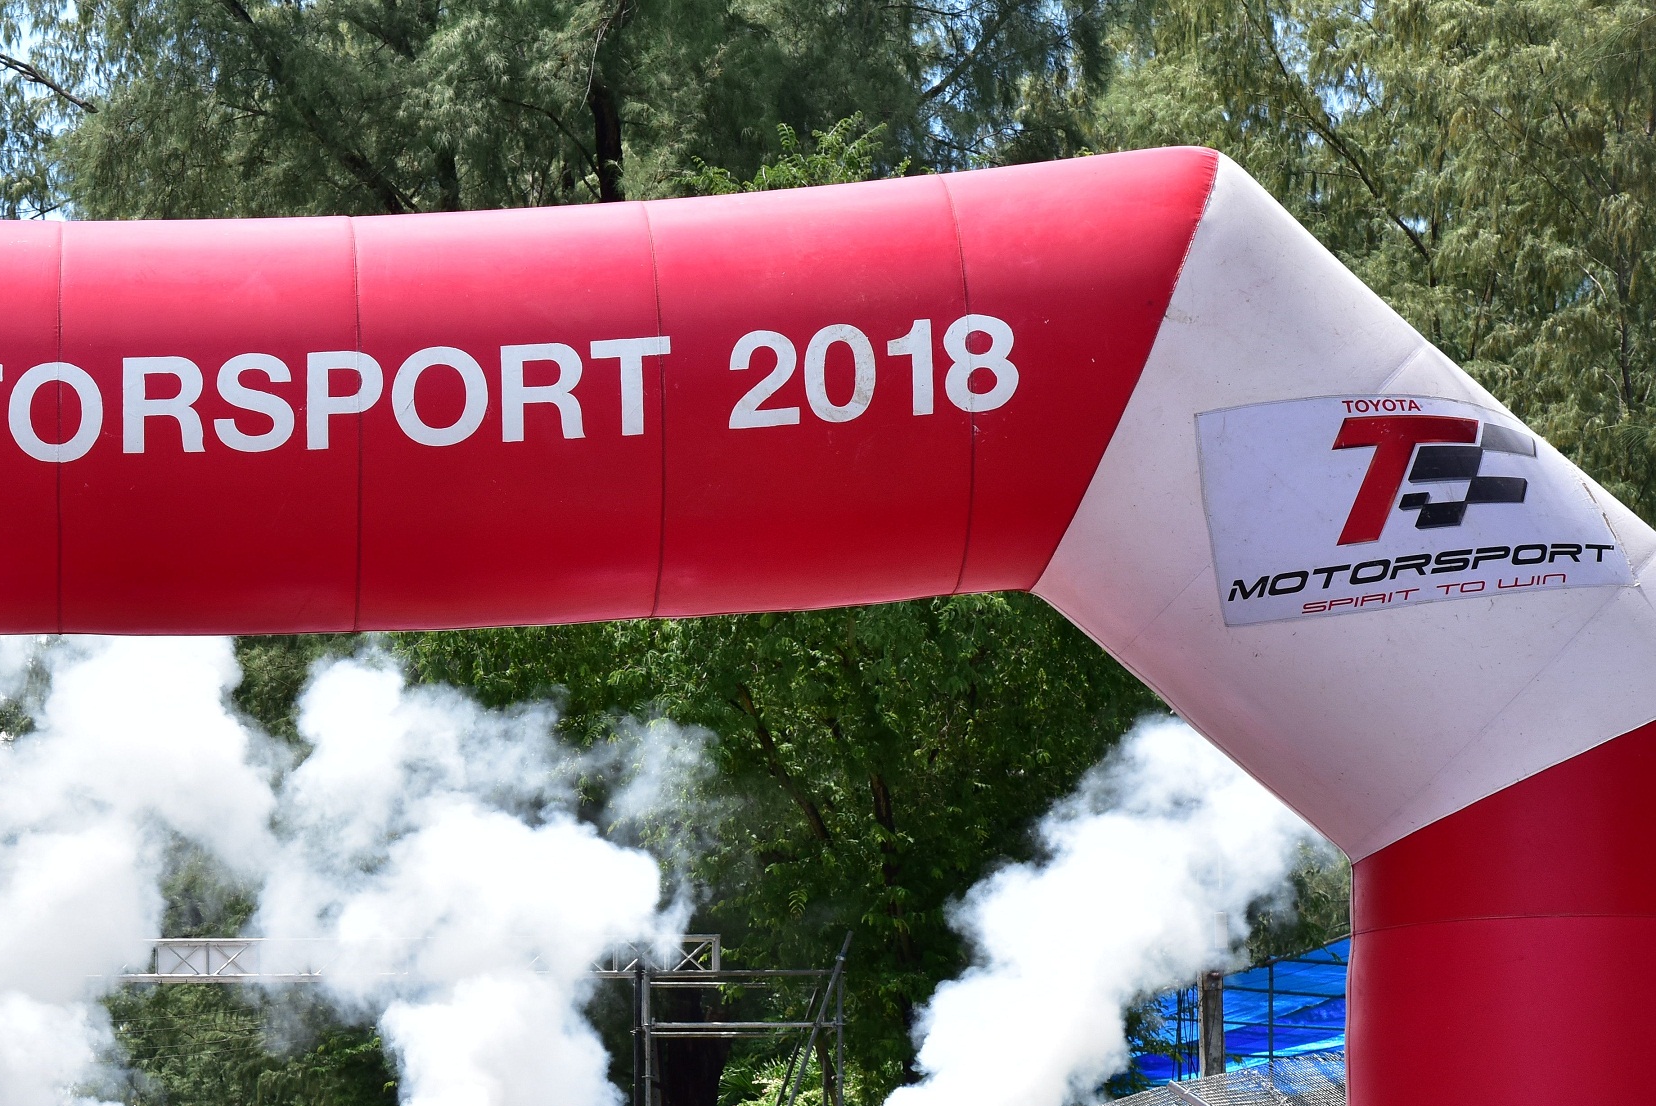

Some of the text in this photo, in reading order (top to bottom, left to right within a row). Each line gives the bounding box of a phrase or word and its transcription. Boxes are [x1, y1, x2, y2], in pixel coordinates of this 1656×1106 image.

[729, 314, 1019, 430] 2018
[1342, 398, 1422, 414] TOYOTA
[1228, 543, 1614, 602] MOTORSPORT
[1301, 573, 1567, 614] SPIRIT TO WIN
